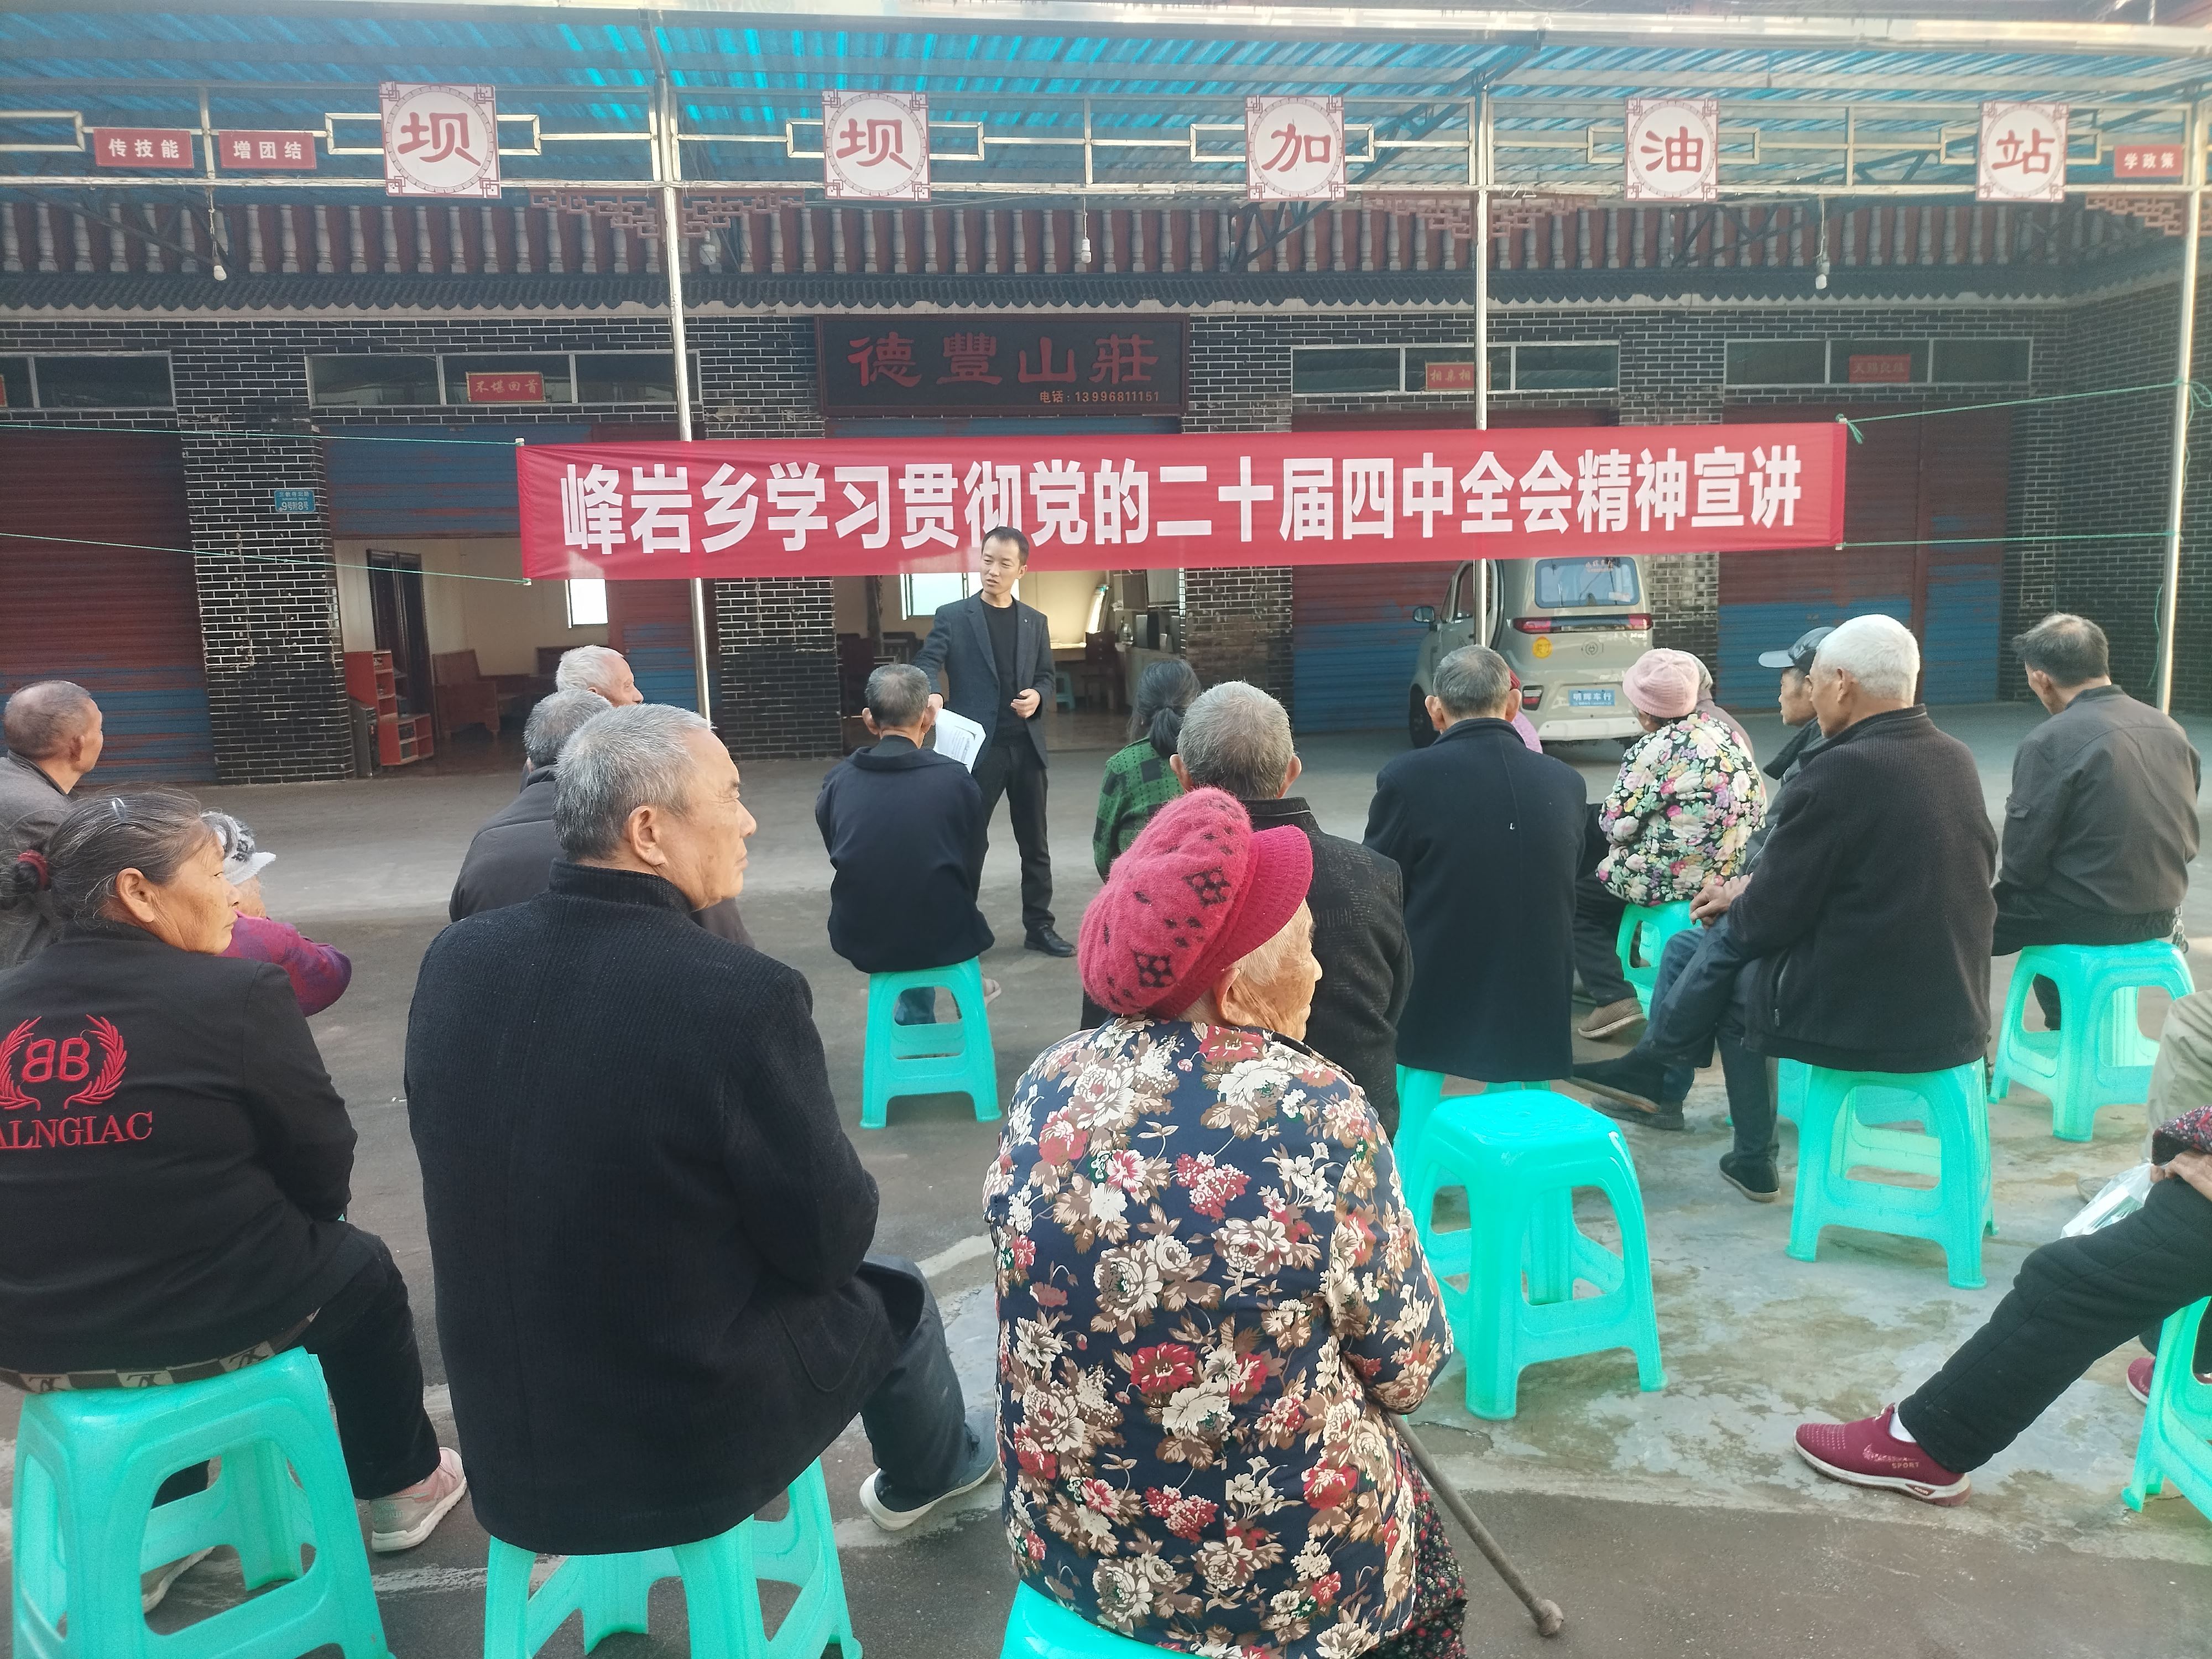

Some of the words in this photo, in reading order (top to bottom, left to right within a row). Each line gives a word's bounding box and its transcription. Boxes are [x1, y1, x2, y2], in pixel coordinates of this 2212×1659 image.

[108, 137, 180, 159] 传技能
[233, 140, 302, 160] 增团结
[397, 112, 481, 167] 坝
[836, 118, 913, 170] 坝
[1261, 123, 1332, 173] 加
[1640, 126, 1704, 173] 油
[1991, 128, 2056, 175] 站
[847, 331, 1159, 387] 德豐山莊
[1430, 368, 1472, 382] 相亲相
[476, 379, 539, 394] 不堪回首
[560, 445, 1802, 555] 峰岩乡学习贯彻党的二十届四中全会精神宣讲
